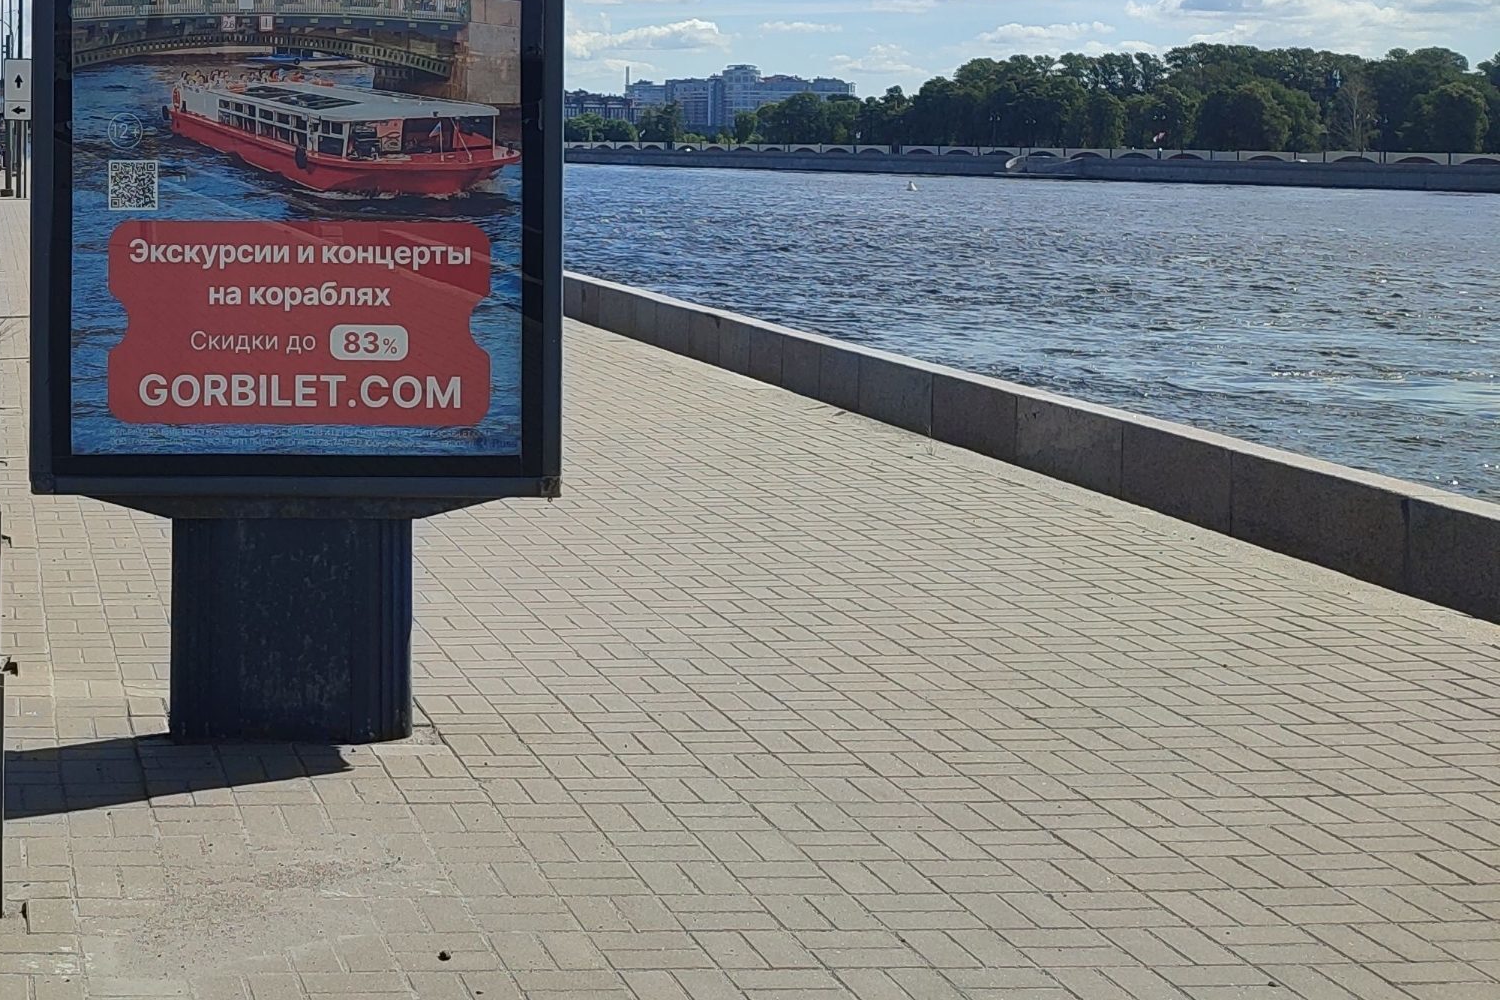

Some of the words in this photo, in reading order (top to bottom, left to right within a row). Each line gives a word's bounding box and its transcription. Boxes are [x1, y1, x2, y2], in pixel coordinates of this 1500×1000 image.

[111, 122, 140, 139] 12+
[129, 239, 289, 269] Экскурсии
[297, 245, 315, 263] и
[322, 244, 472, 269] концерты
[208, 288, 242, 306] на
[249, 283, 391, 311] кораблях
[190, 331, 278, 353] Скидки
[286, 335, 316, 354] до
[343, 332, 398, 355] 83%
[138, 373, 462, 409] GORBILET.COM
